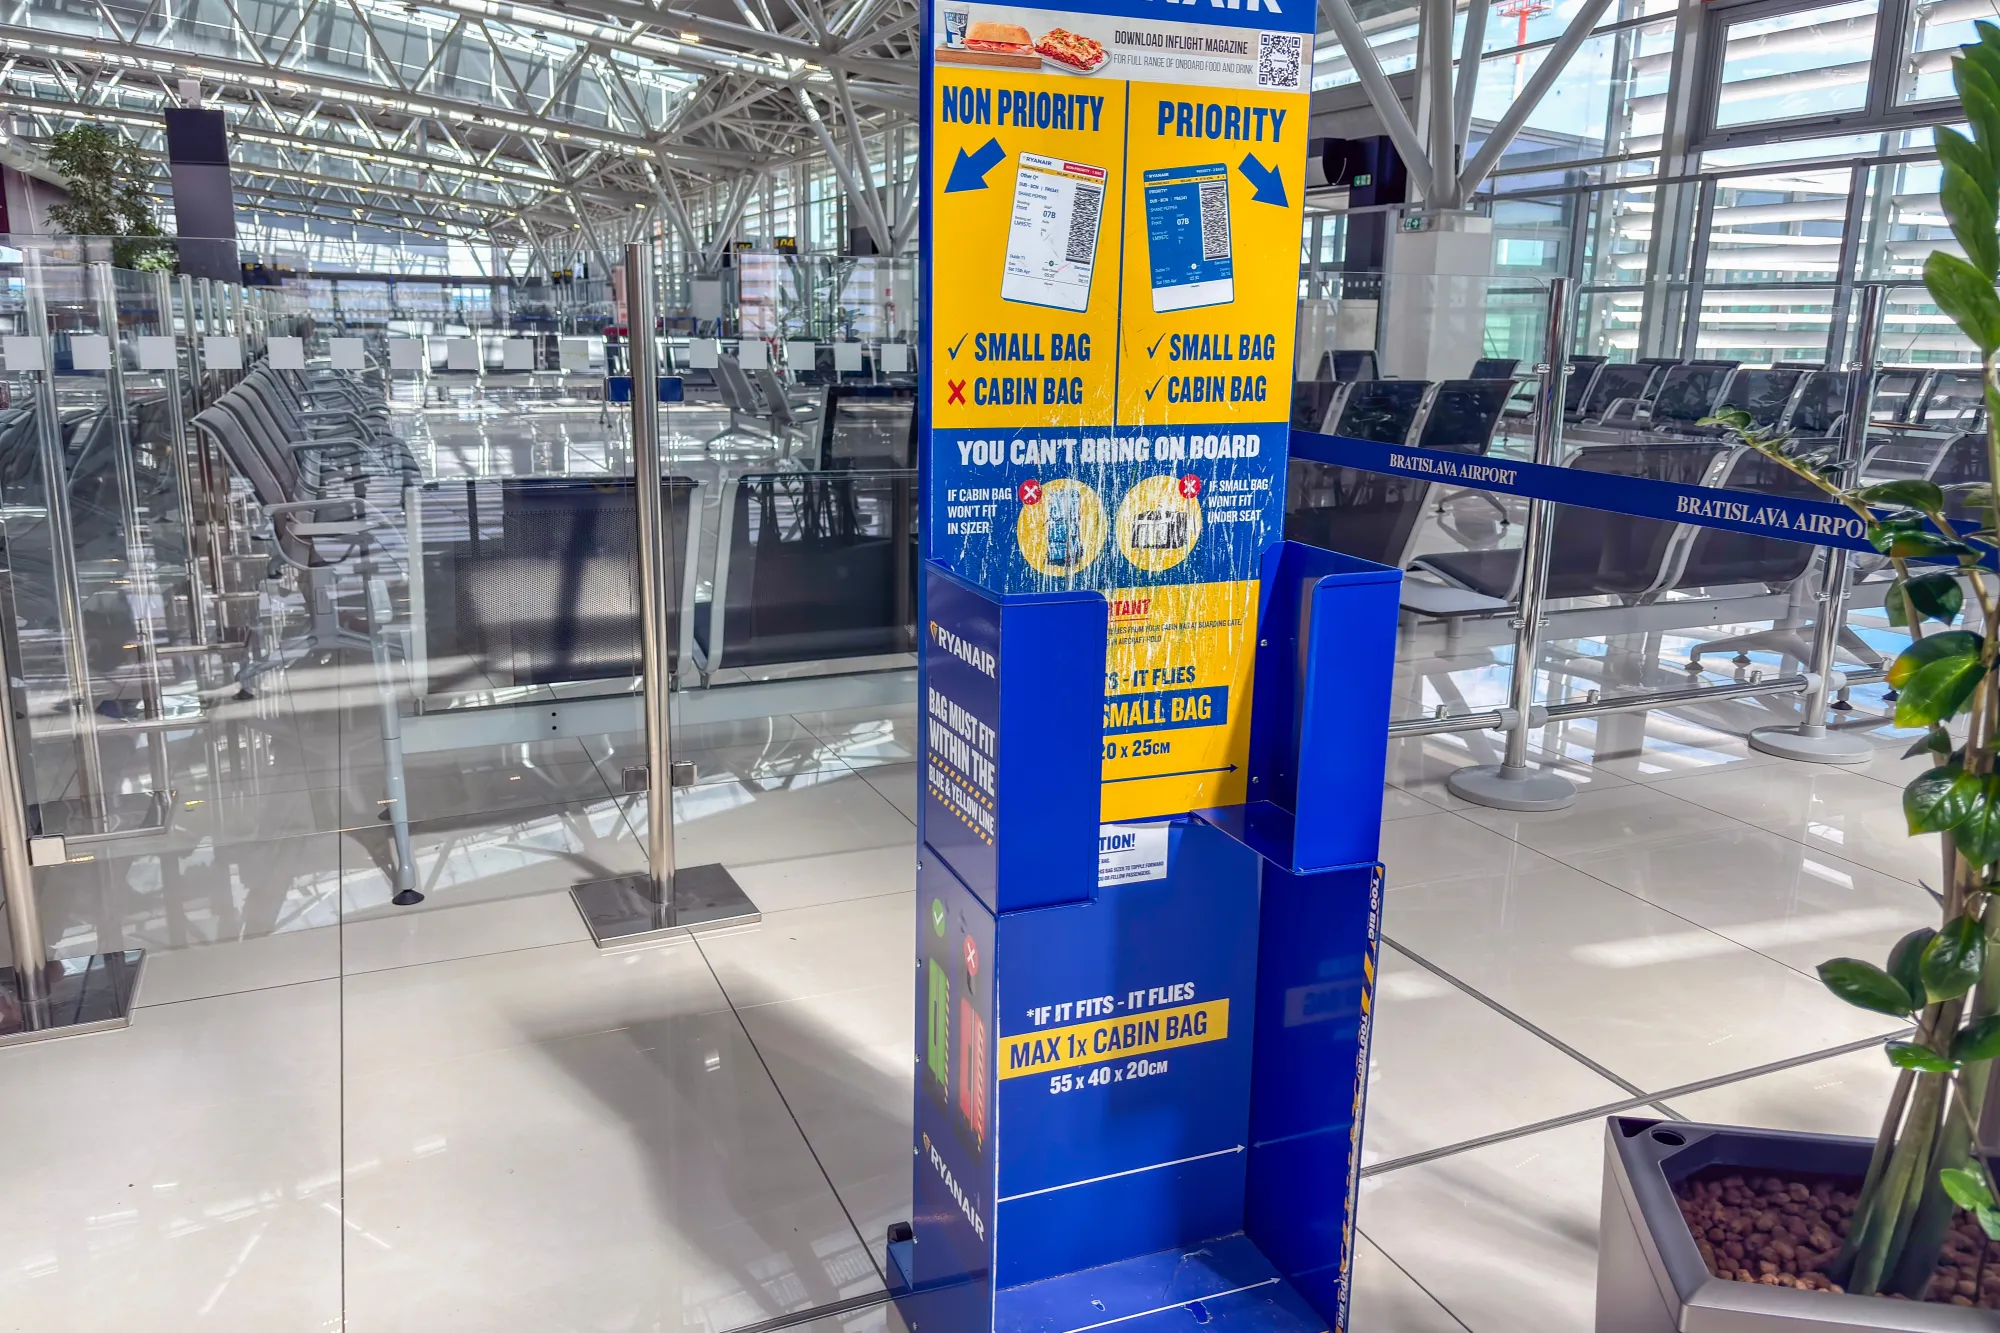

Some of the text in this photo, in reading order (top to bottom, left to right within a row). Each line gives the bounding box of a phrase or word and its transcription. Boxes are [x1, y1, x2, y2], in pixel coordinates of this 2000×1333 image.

[1114, 30, 1249, 55] DOWNLOAD INFLIGHT MAGAZINE
[1113, 53, 1253, 75] FOR FULL RANGE OF ONBOARD FOOD AND DRINK
[942, 85, 1105, 132] NON PRIORITY
[1157, 100, 1287, 144] PRIORITY
[1025, 156, 1052, 166] RYANAIR
[1042, 210, 1057, 219] 07B
[1176, 217, 1190, 226] 07B
[974, 332, 1091, 362] SMALL BAG
[1168, 333, 1276, 361] SMALL BAG
[974, 376, 1083, 406] CABIN BAG
[1167, 375, 1267, 403] CABIN BAG
[956, 434, 1261, 466] YOU CAN'T BRING ON BOARD
[1389, 453, 1518, 486] BRATISLAVA AIRPORT
[947, 487, 1012, 502] IF CABIN BAG
[1208, 478, 1269, 493] IF SMALL BAG
[947, 503, 998, 519] WON'T FIT
[1238, 494, 1253, 507] FIT
[1676, 495, 1790, 529] BRATISLAVA
[947, 520, 990, 535] IN SIZER
[1207, 509, 1262, 524] UNDER SEAT
[937, 625, 996, 679] RYANAIR
[1105, 671, 1119, 690] S
[1132, 669, 1148, 687] IT
[1152, 665, 1196, 686] FLIES
[928, 686, 996, 758] BAG MUST FIT
[1171, 694, 1212, 722] BAG
[928, 716, 995, 798] WITHIN THE
[928, 762, 995, 837] BLUE & YELLOW LINE
[1367, 877, 1380, 941] TOO BIG
[1054, 1002, 1073, 1023] IT
[1075, 995, 1115, 1019] FITS
[1128, 989, 1146, 1010] IT
[1148, 981, 1196, 1007] FLIES
[1009, 1010, 1208, 1070] MAX 1x CABIN BAG
[1050, 1073, 1073, 1095] 55
[1088, 1066, 1111, 1087] 40
[930, 1143, 985, 1243] RYANAIR
